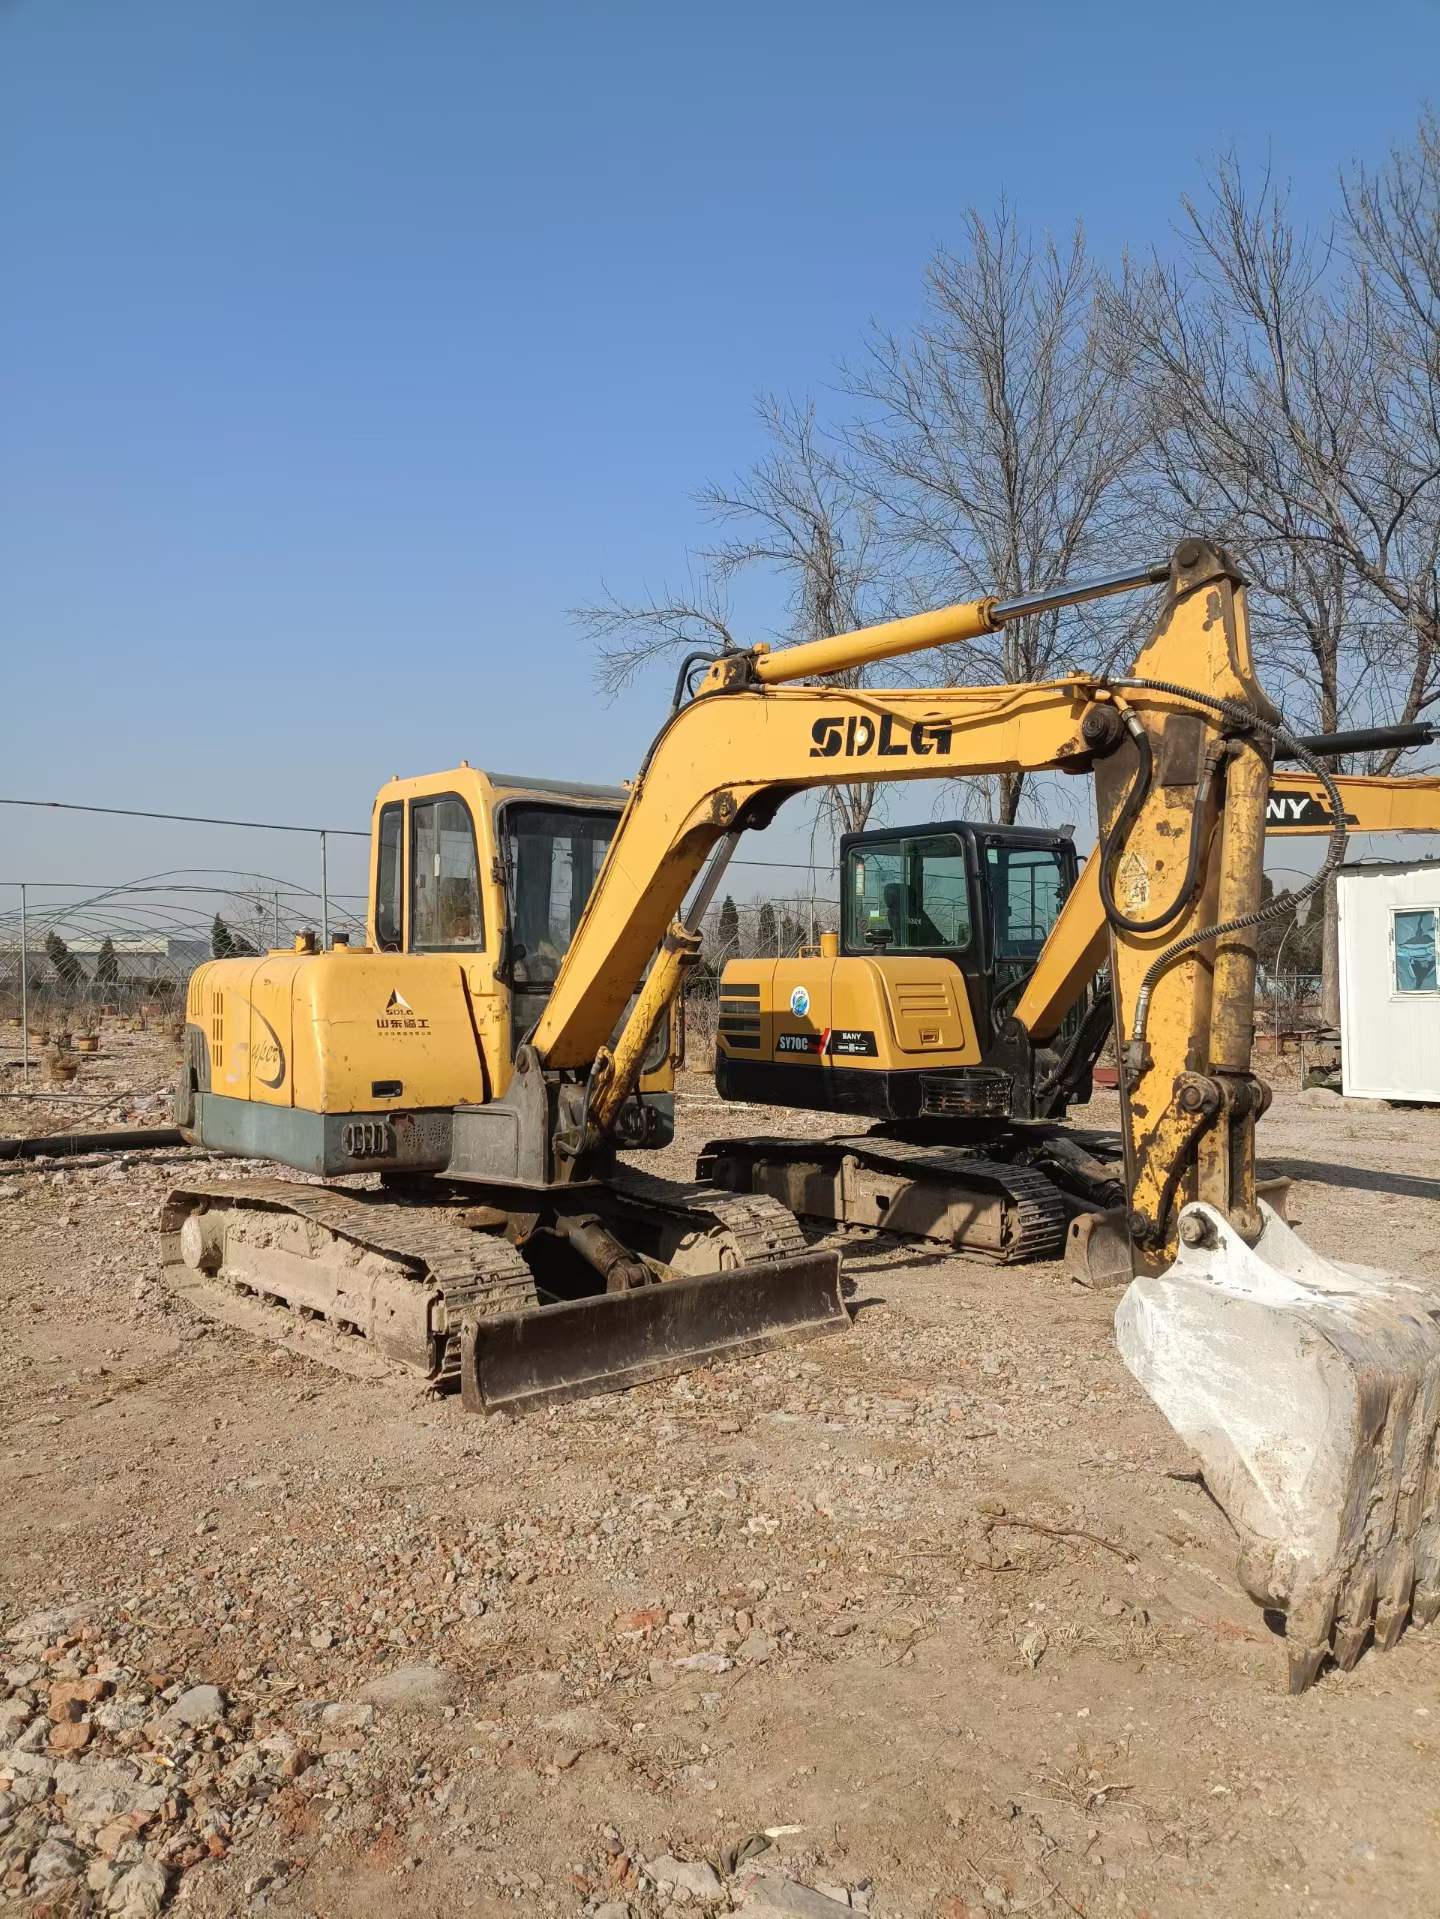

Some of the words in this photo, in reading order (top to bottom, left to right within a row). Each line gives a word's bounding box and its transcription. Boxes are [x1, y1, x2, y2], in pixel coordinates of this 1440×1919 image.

[809, 713, 953, 758] SDLG
[1265, 798, 1311, 820] NY
[376, 1018, 431, 1029] 山东临工
[779, 1036, 809, 1051] SY70C
[842, 1032, 861, 1040] SANY
